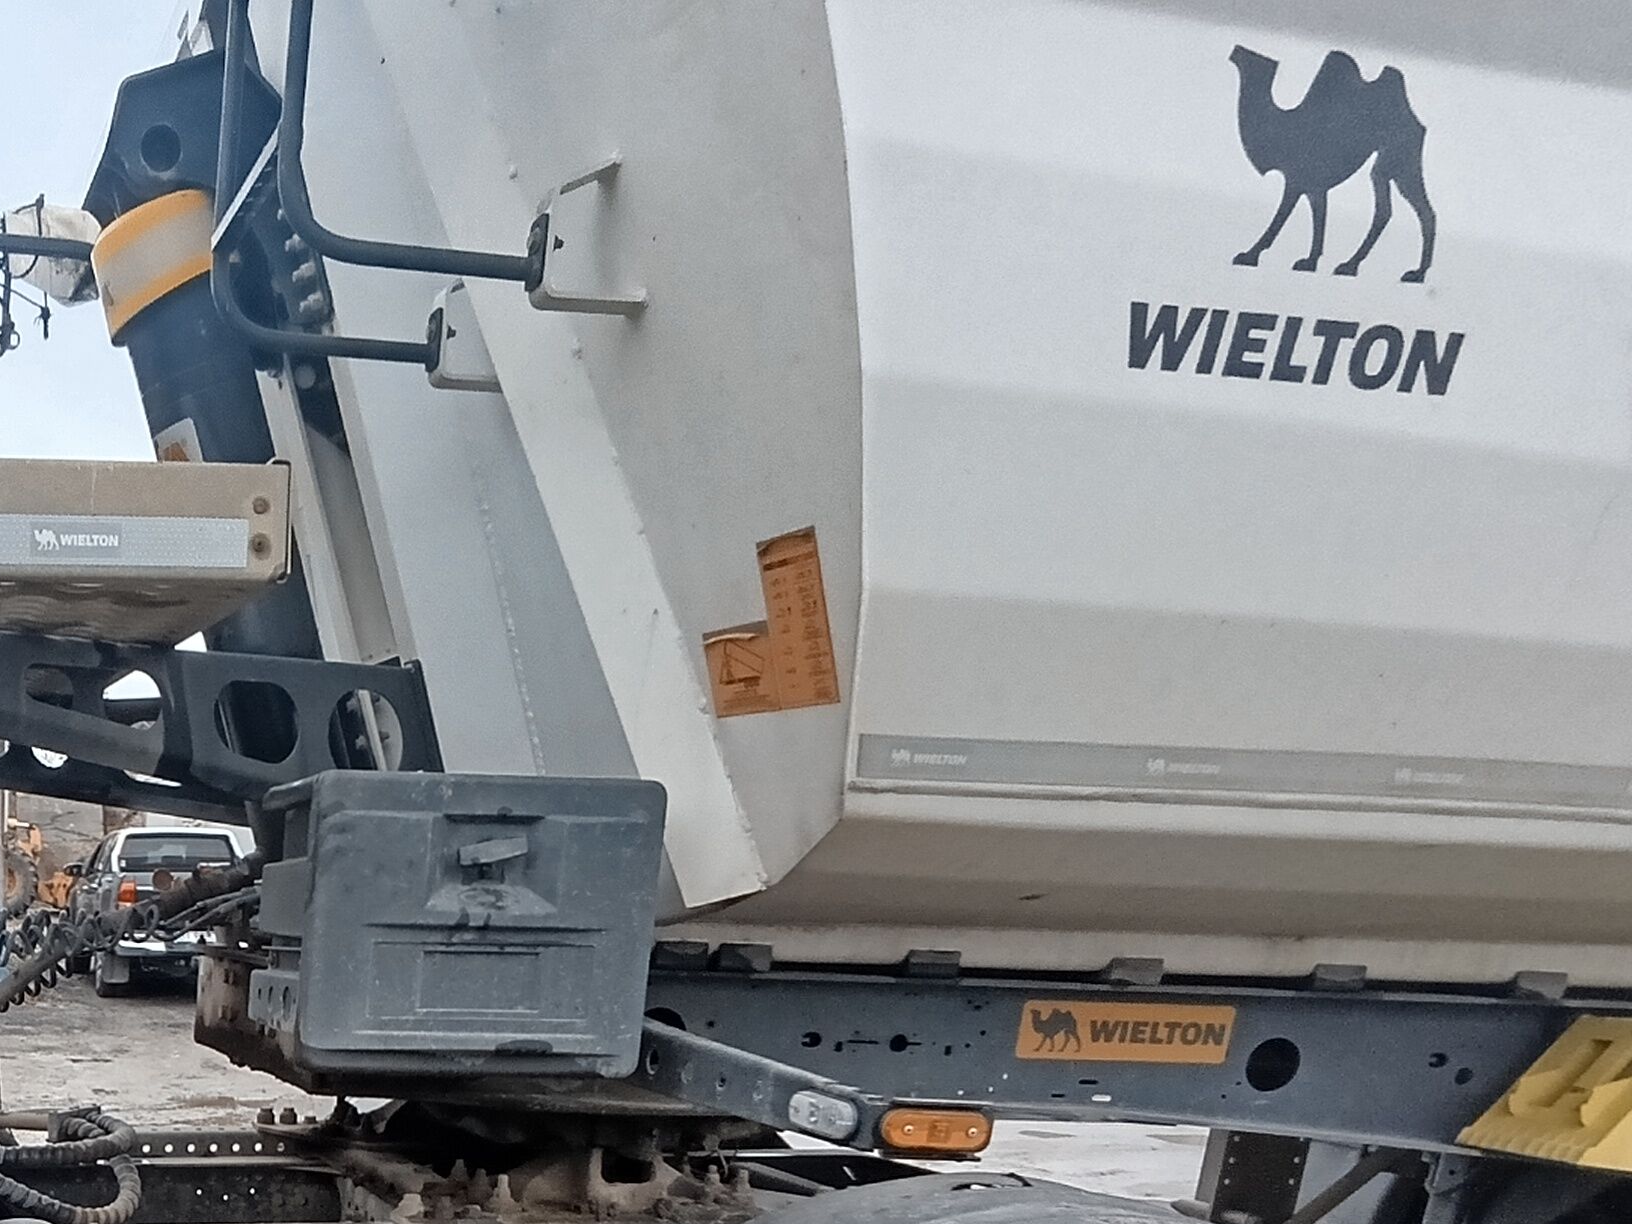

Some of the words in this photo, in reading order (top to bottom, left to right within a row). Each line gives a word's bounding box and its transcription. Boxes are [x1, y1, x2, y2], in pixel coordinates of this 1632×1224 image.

[1127, 301, 1466, 397] WIELTON
[60, 534, 119, 547] WIELTON
[913, 753, 968, 766] WIELTON
[1090, 1019, 1227, 1047] WIELTON
